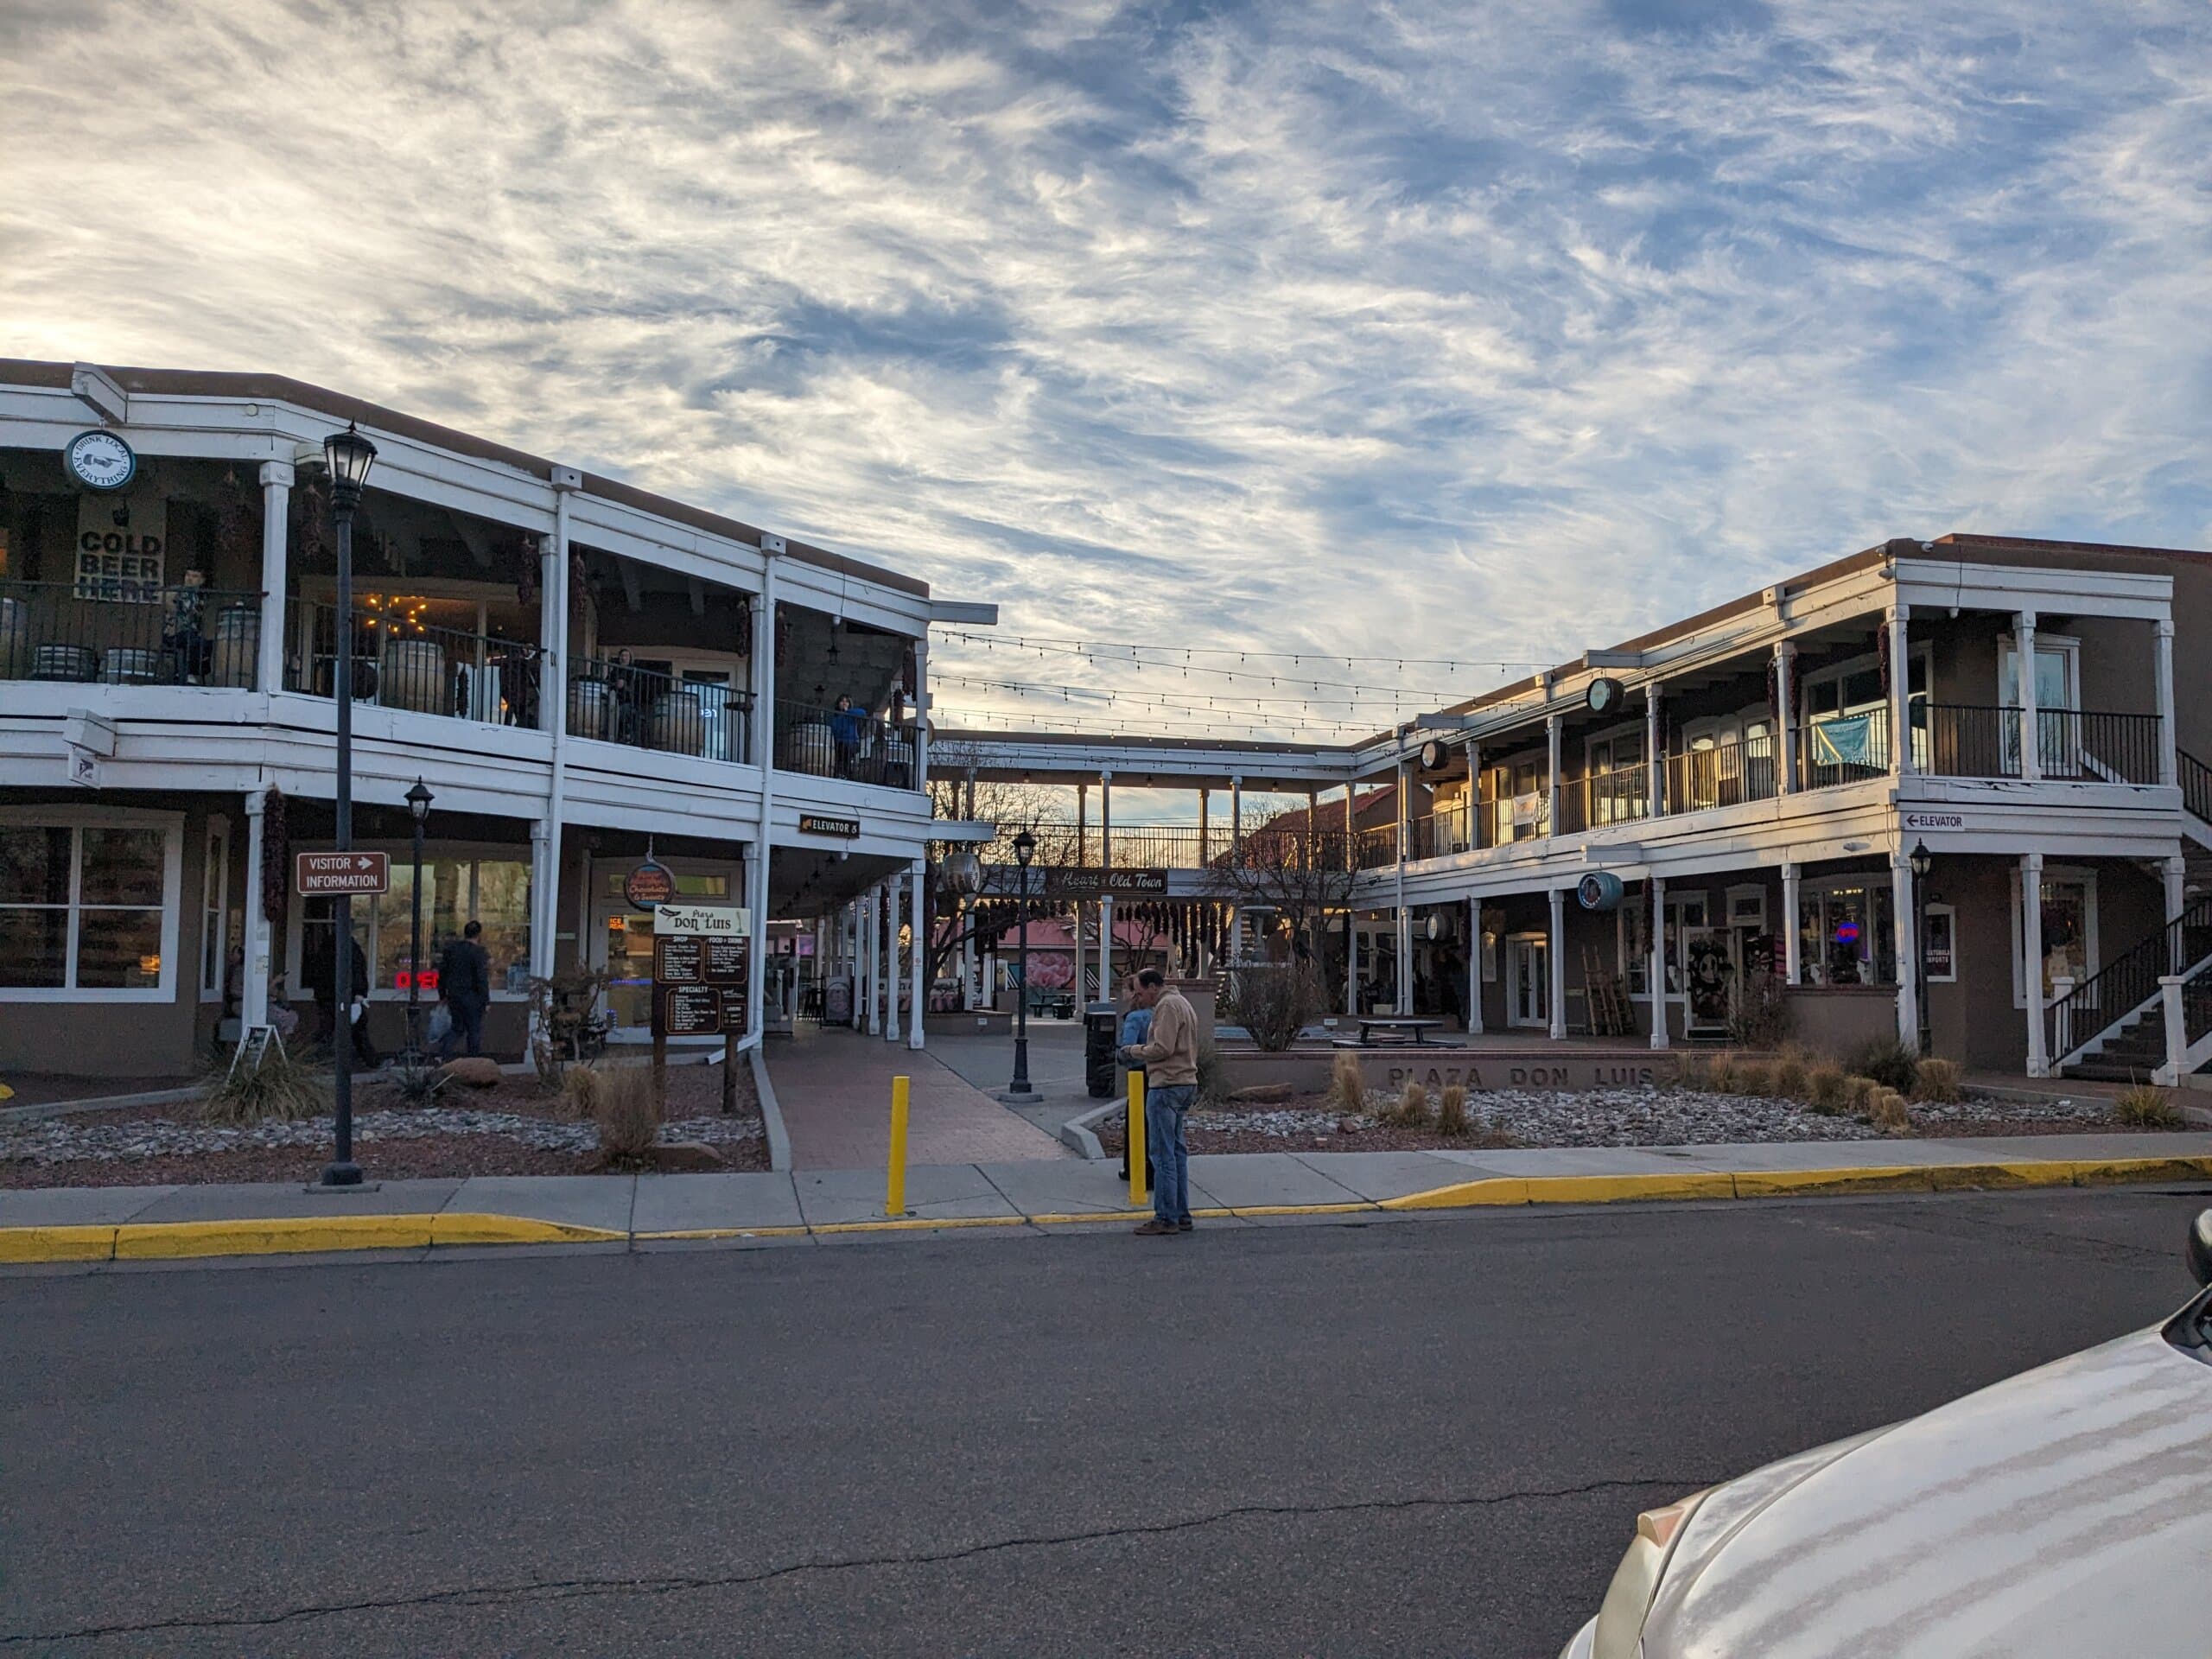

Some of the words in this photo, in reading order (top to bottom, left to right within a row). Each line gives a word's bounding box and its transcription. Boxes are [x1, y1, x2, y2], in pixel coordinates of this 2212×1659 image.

[75, 436, 102, 451] DRINK
[105, 437, 128, 458] LOCAL
[73, 456, 129, 485] EVERYTHING
[81, 531, 162, 554] COLD
[80, 554, 159, 578] BEER
[813, 819, 849, 834] ELEVATOR
[1920, 815, 1962, 827] ELEVATOR
[309, 857, 351, 870] VISITOR
[307, 874, 378, 887] INFORMATION
[1109, 873, 1132, 887] Old
[1135, 873, 1162, 888] Town
[692, 910, 714, 921] Plaza
[674, 918, 700, 931] DON
[704, 918, 731, 930] LUIS
[1388, 1068, 1483, 1086] PLAZA
[1510, 1068, 1569, 1086] DON
[1595, 1068, 1653, 1085] LUIS
